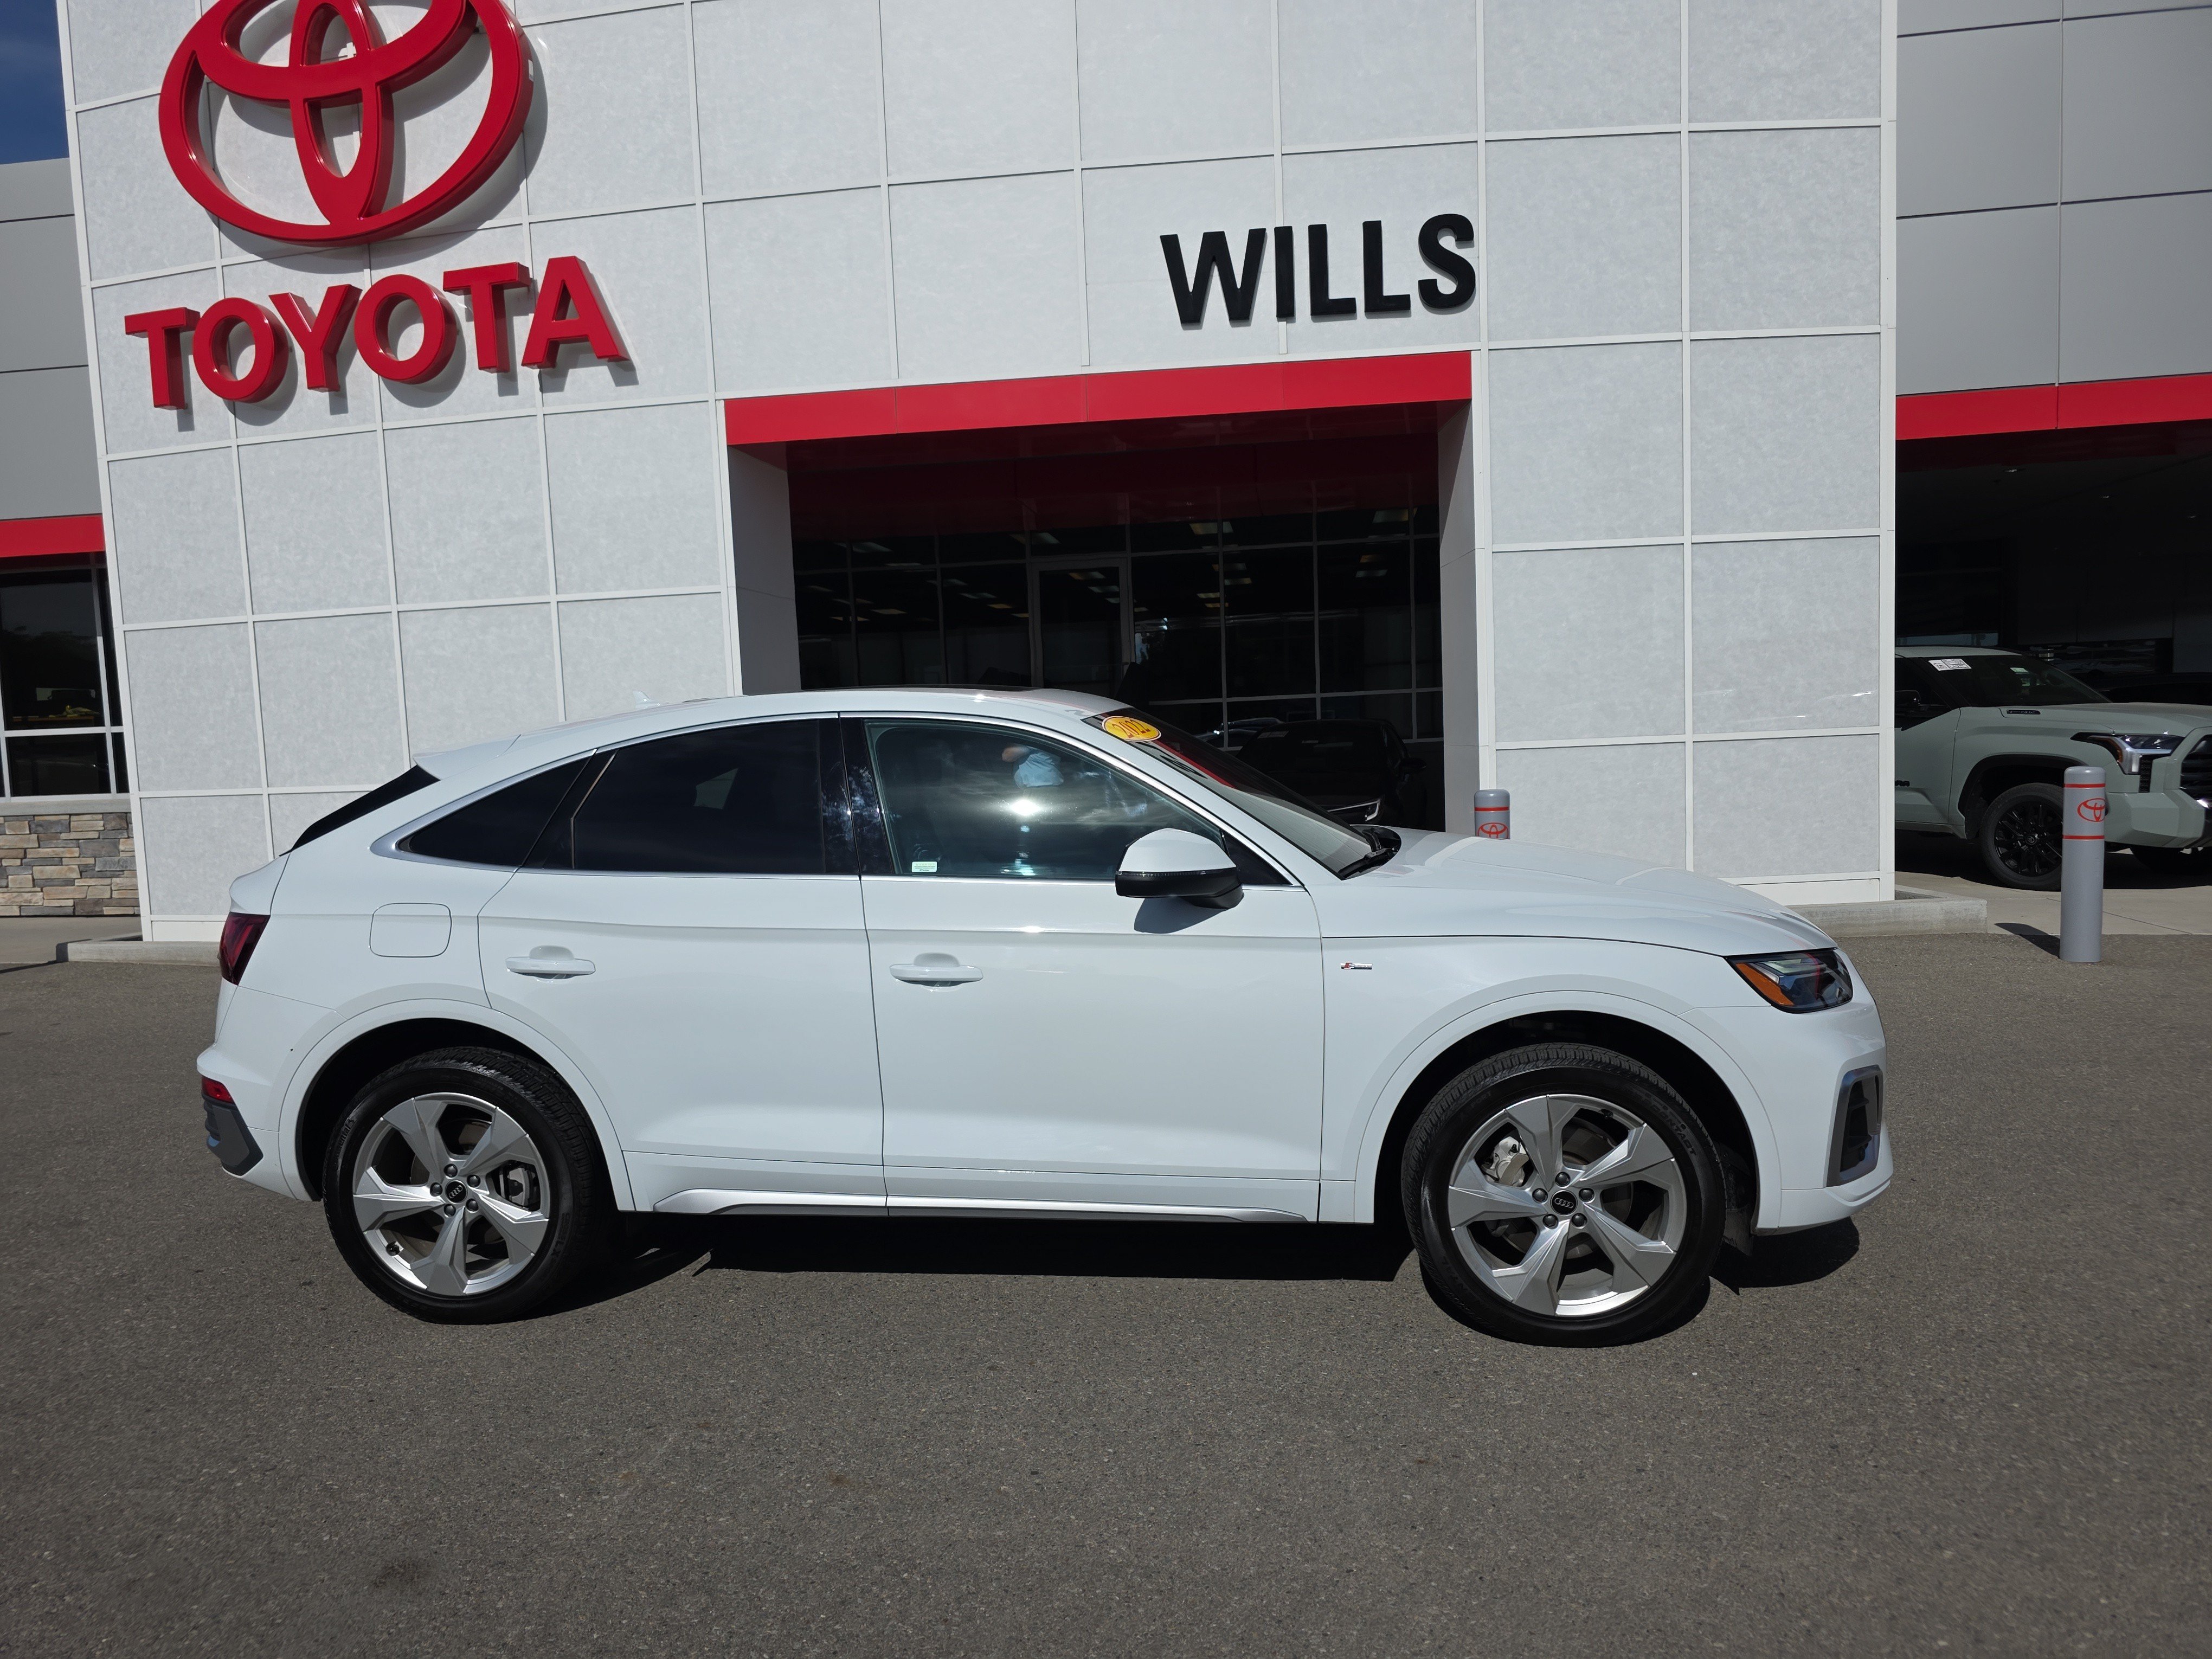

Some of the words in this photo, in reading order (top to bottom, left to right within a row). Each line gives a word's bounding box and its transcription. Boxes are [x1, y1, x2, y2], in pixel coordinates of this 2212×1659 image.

[1160, 213, 1476, 324] WILLS
[124, 255, 630, 411] TOYOTA
[1111, 719, 1151, 738] 2022
